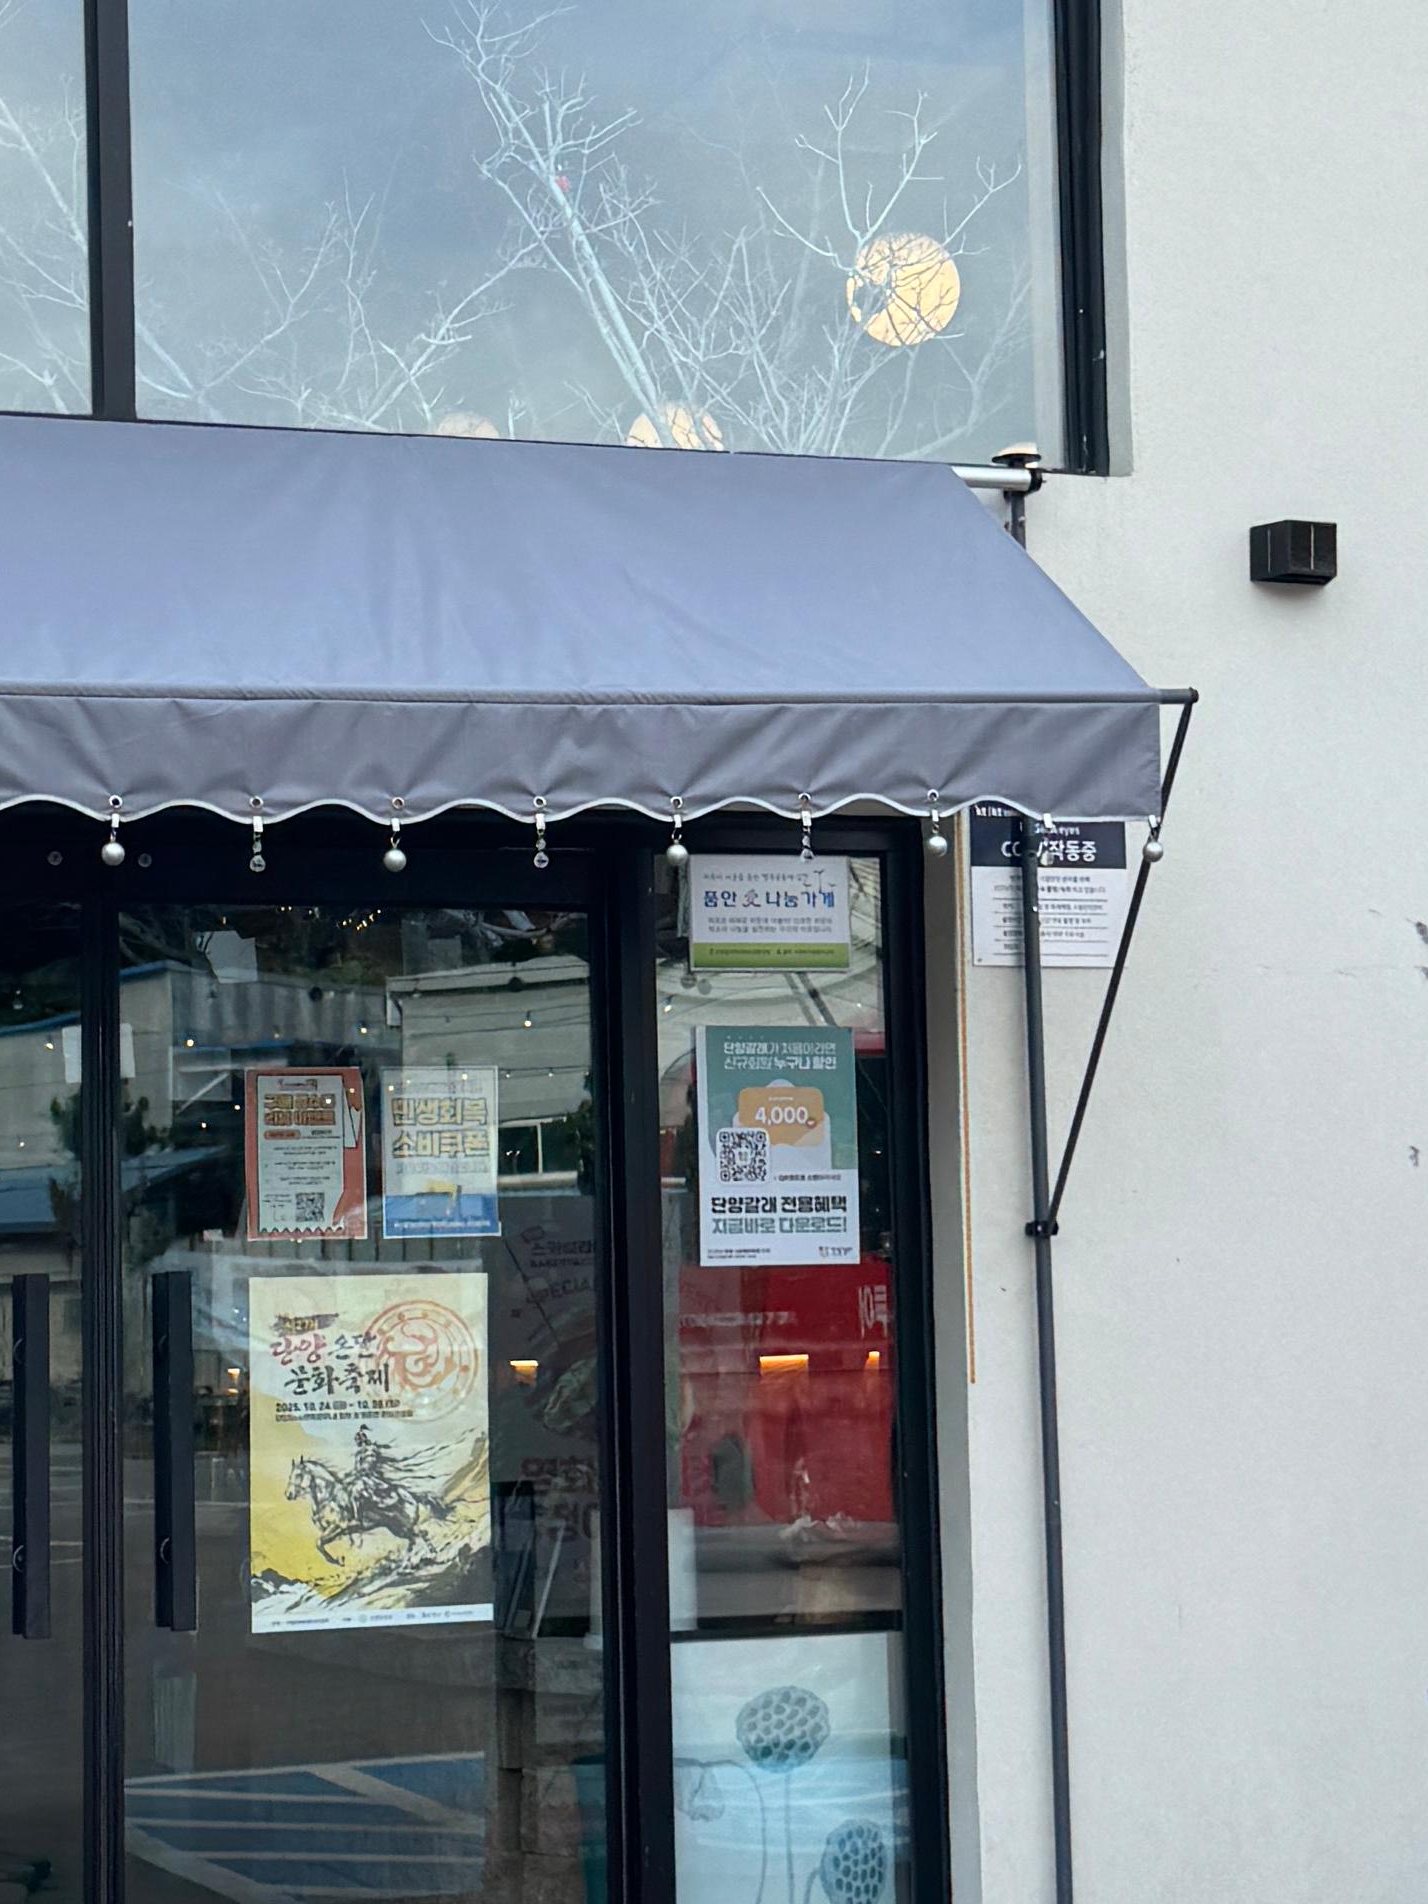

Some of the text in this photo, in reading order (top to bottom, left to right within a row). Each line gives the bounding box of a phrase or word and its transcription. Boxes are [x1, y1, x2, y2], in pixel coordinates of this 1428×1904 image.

[704, 890, 737, 908] 품안
[390, 1096, 489, 1126] 민생회복
[754, 1106, 808, 1125] 4,000
[392, 1128, 491, 1159] 소비쿠폰
[781, 1195, 847, 1213] 전용혜택
[711, 1217, 775, 1234] 지금바로
[284, 1361, 390, 1396] 문화축제
